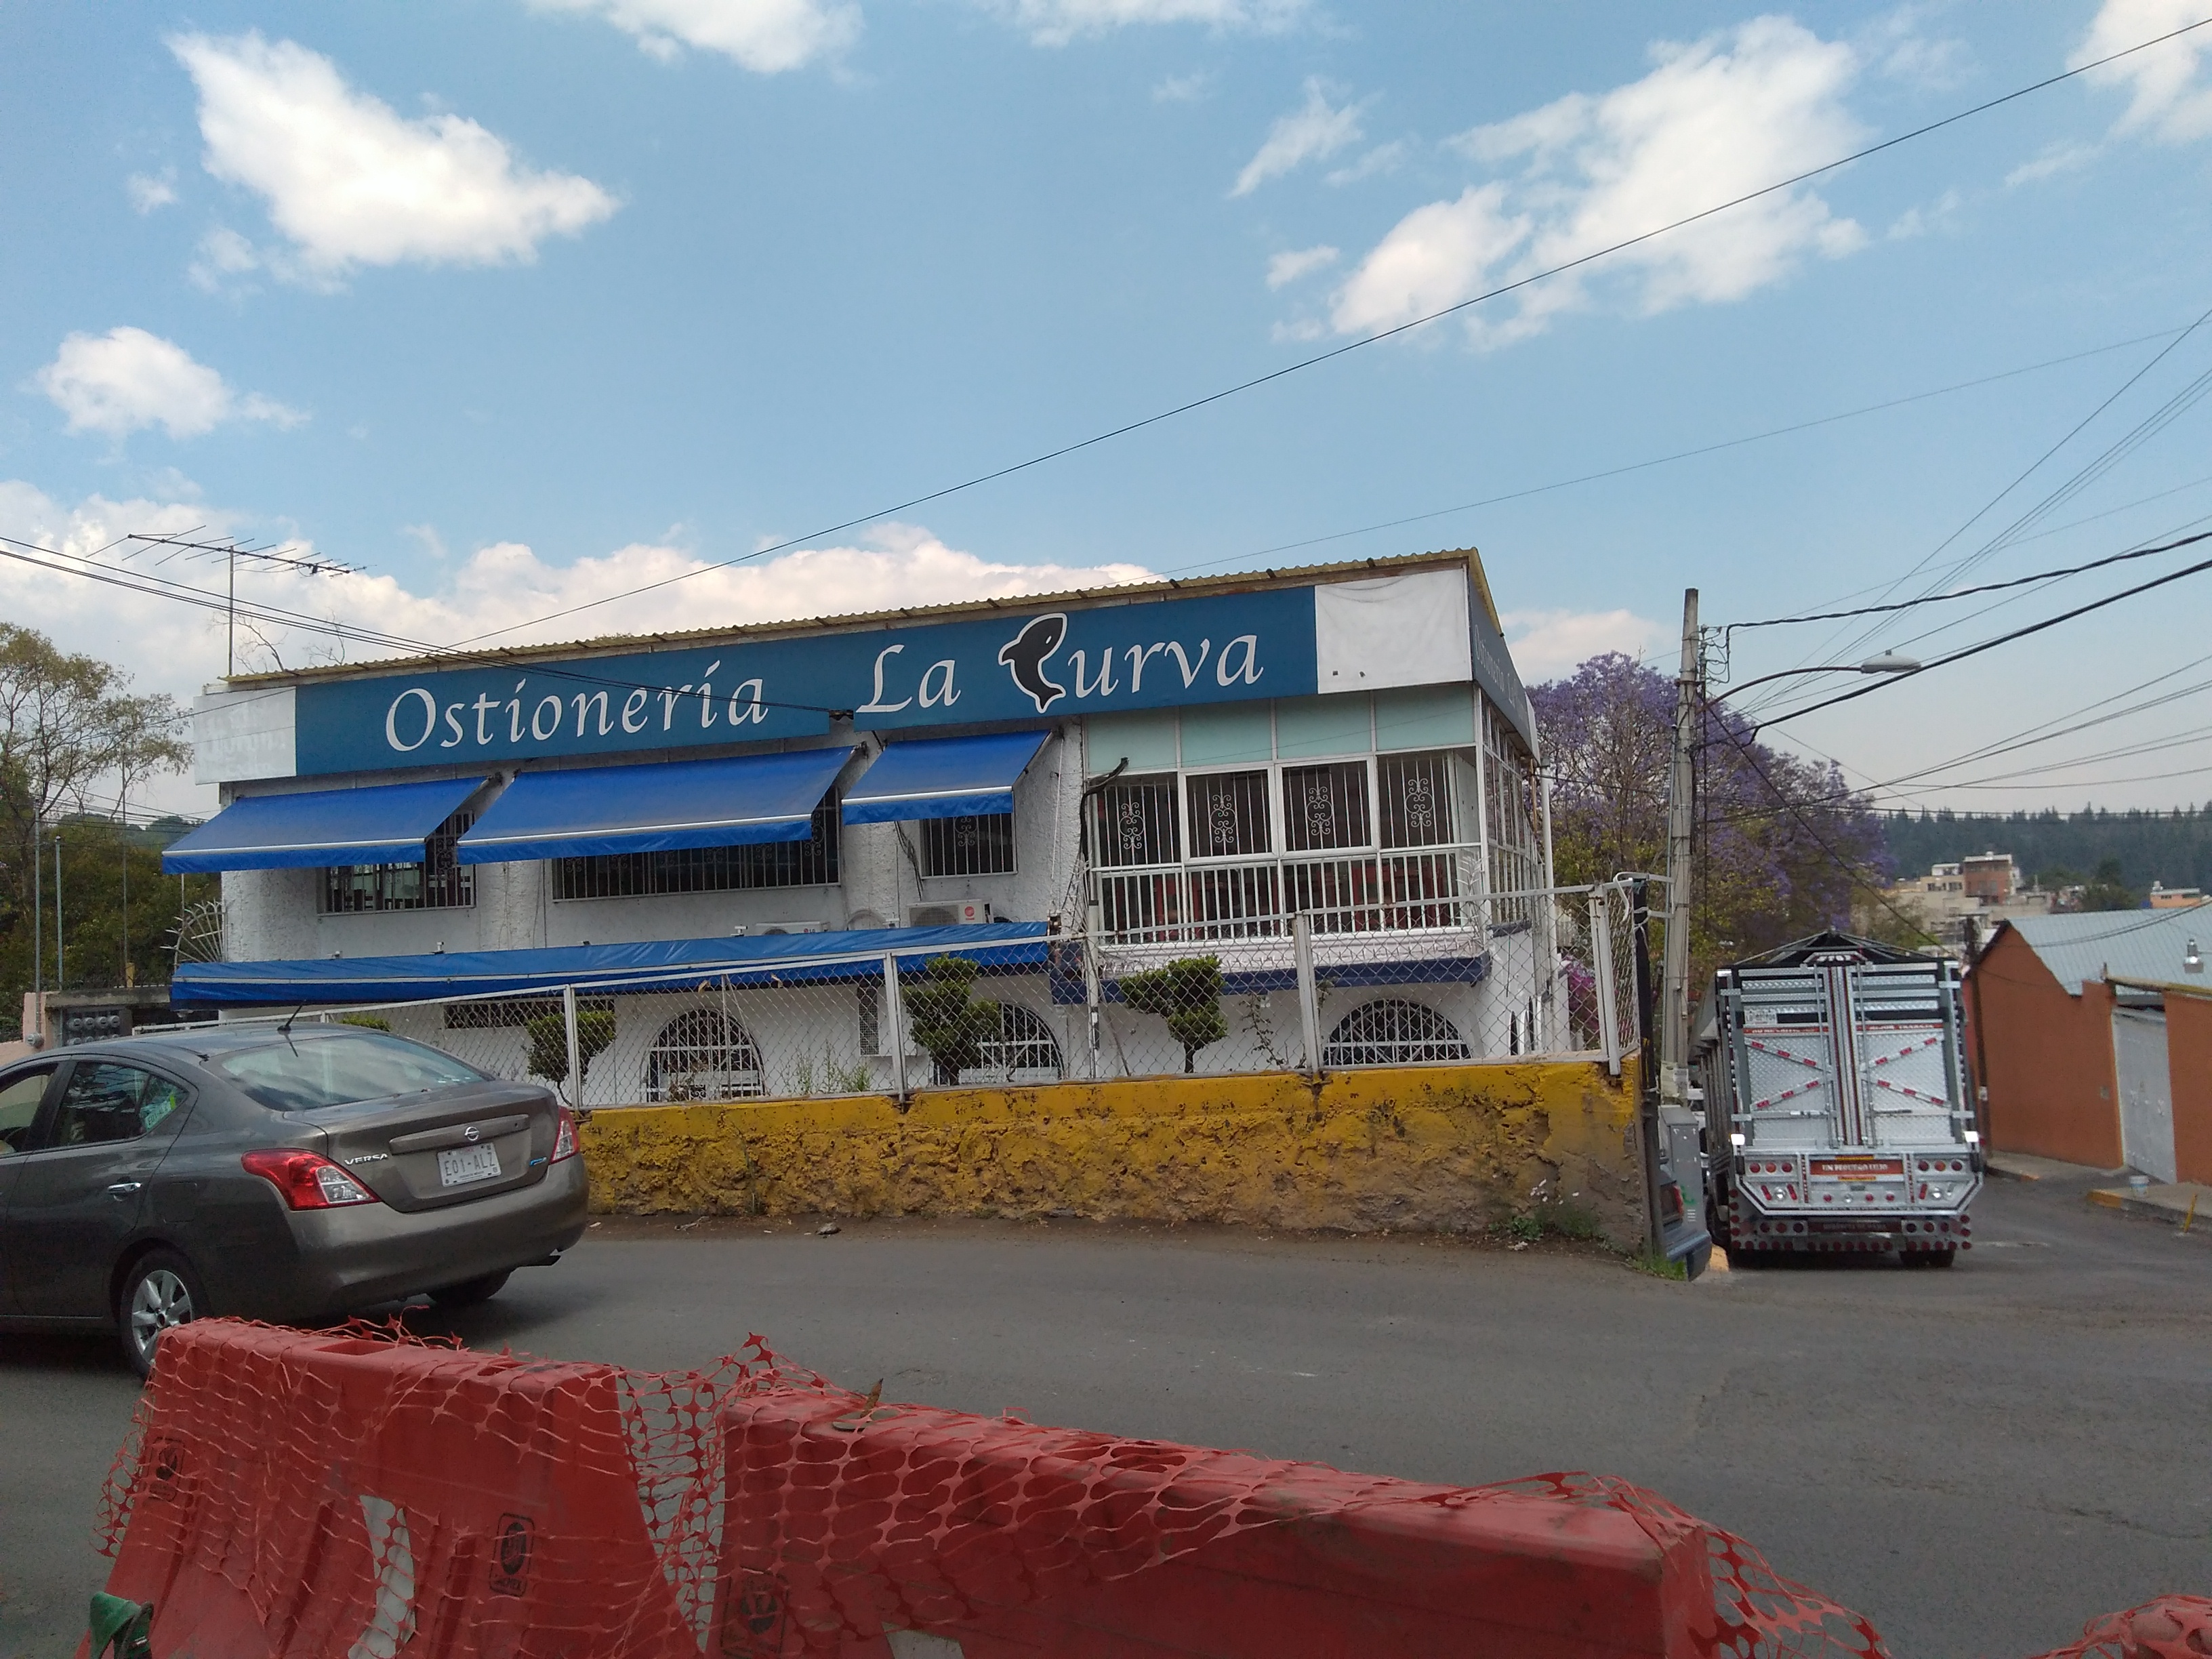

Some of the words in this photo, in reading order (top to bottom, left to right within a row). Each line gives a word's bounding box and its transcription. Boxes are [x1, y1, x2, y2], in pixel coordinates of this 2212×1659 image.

[386, 659, 769, 752] Ostionería
[855, 643, 961, 713] La
[344, 1153, 388, 1166] VERSA
